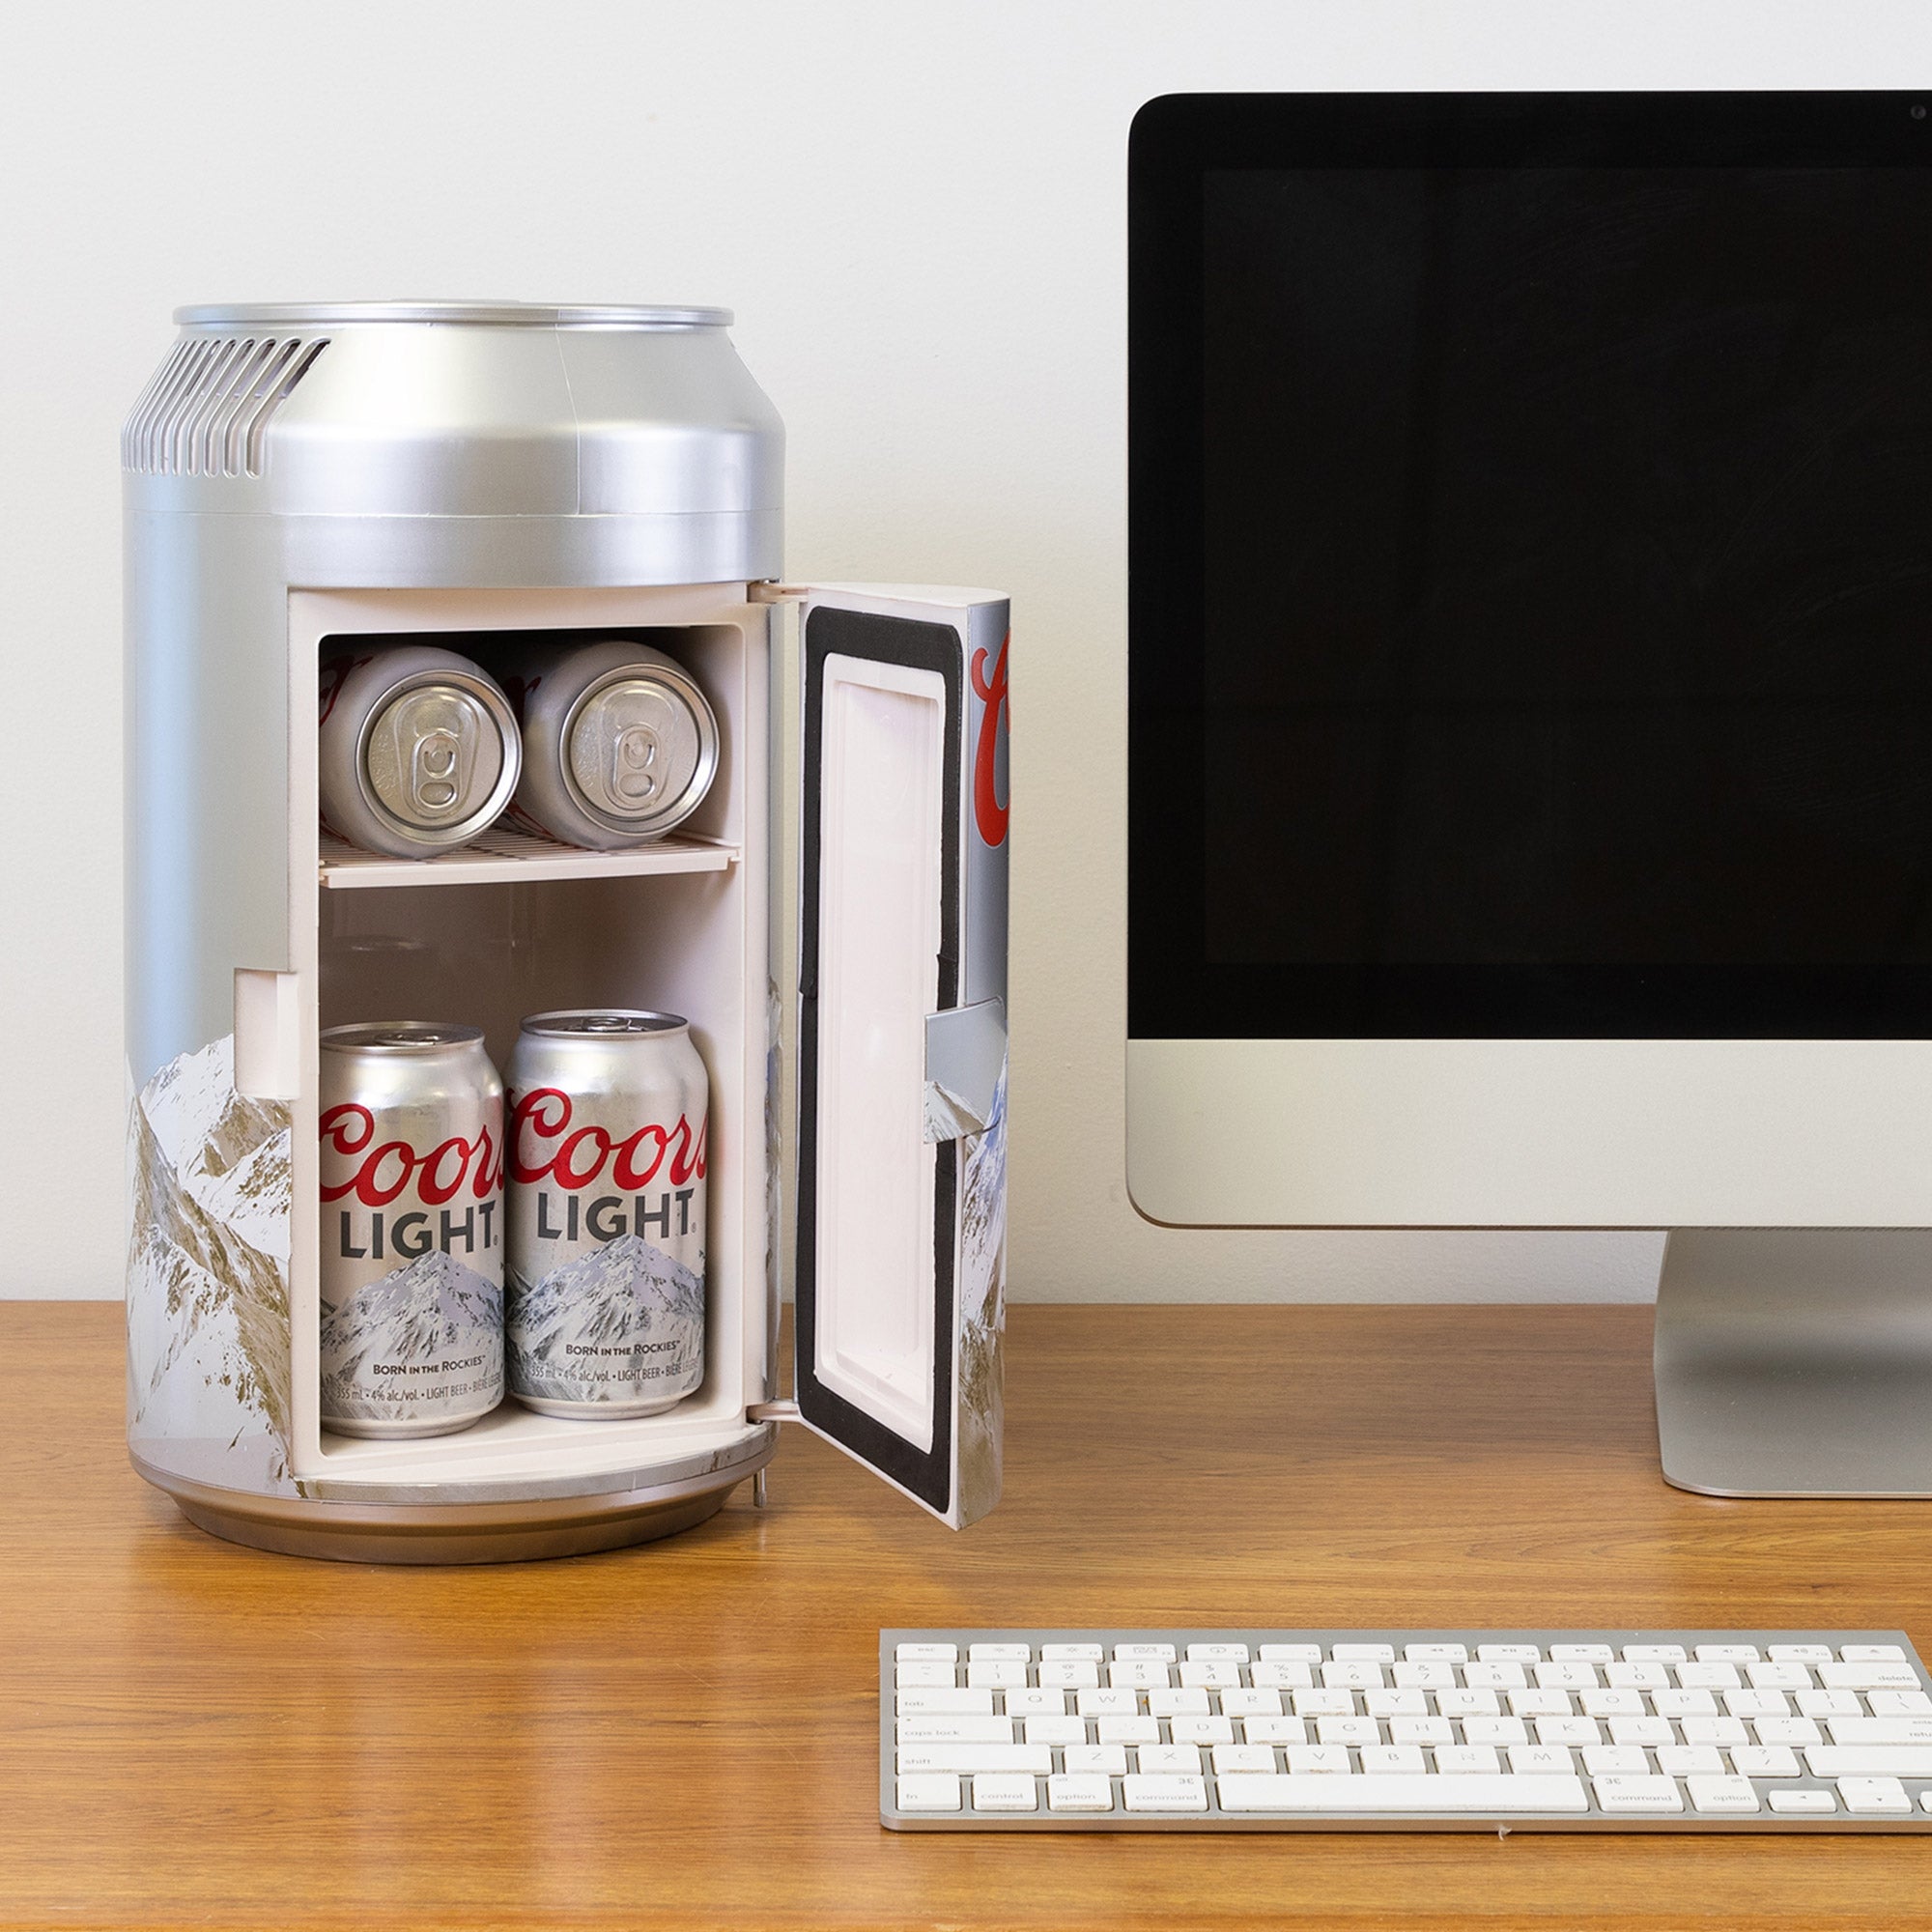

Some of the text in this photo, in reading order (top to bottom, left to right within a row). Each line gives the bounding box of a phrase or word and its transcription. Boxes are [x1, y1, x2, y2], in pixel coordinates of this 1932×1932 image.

[320, 1103, 503, 1207] Coor
[537, 1188, 695, 1242] LIGHT
[341, 1200, 496, 1259] LIGHT
[566, 1344, 598, 1355] BORN
[373, 1364, 406, 1375] BORN
[409, 1366, 420, 1375] IN
[421, 1365, 439, 1374] THE
[617, 1369, 640, 1381] LIGHT
[641, 1367, 661, 1379] BEER
[427, 1386, 448, 1400] LIGHT
[450, 1383, 469, 1397] BEER
[1712, 1794, 1752, 1804] option
